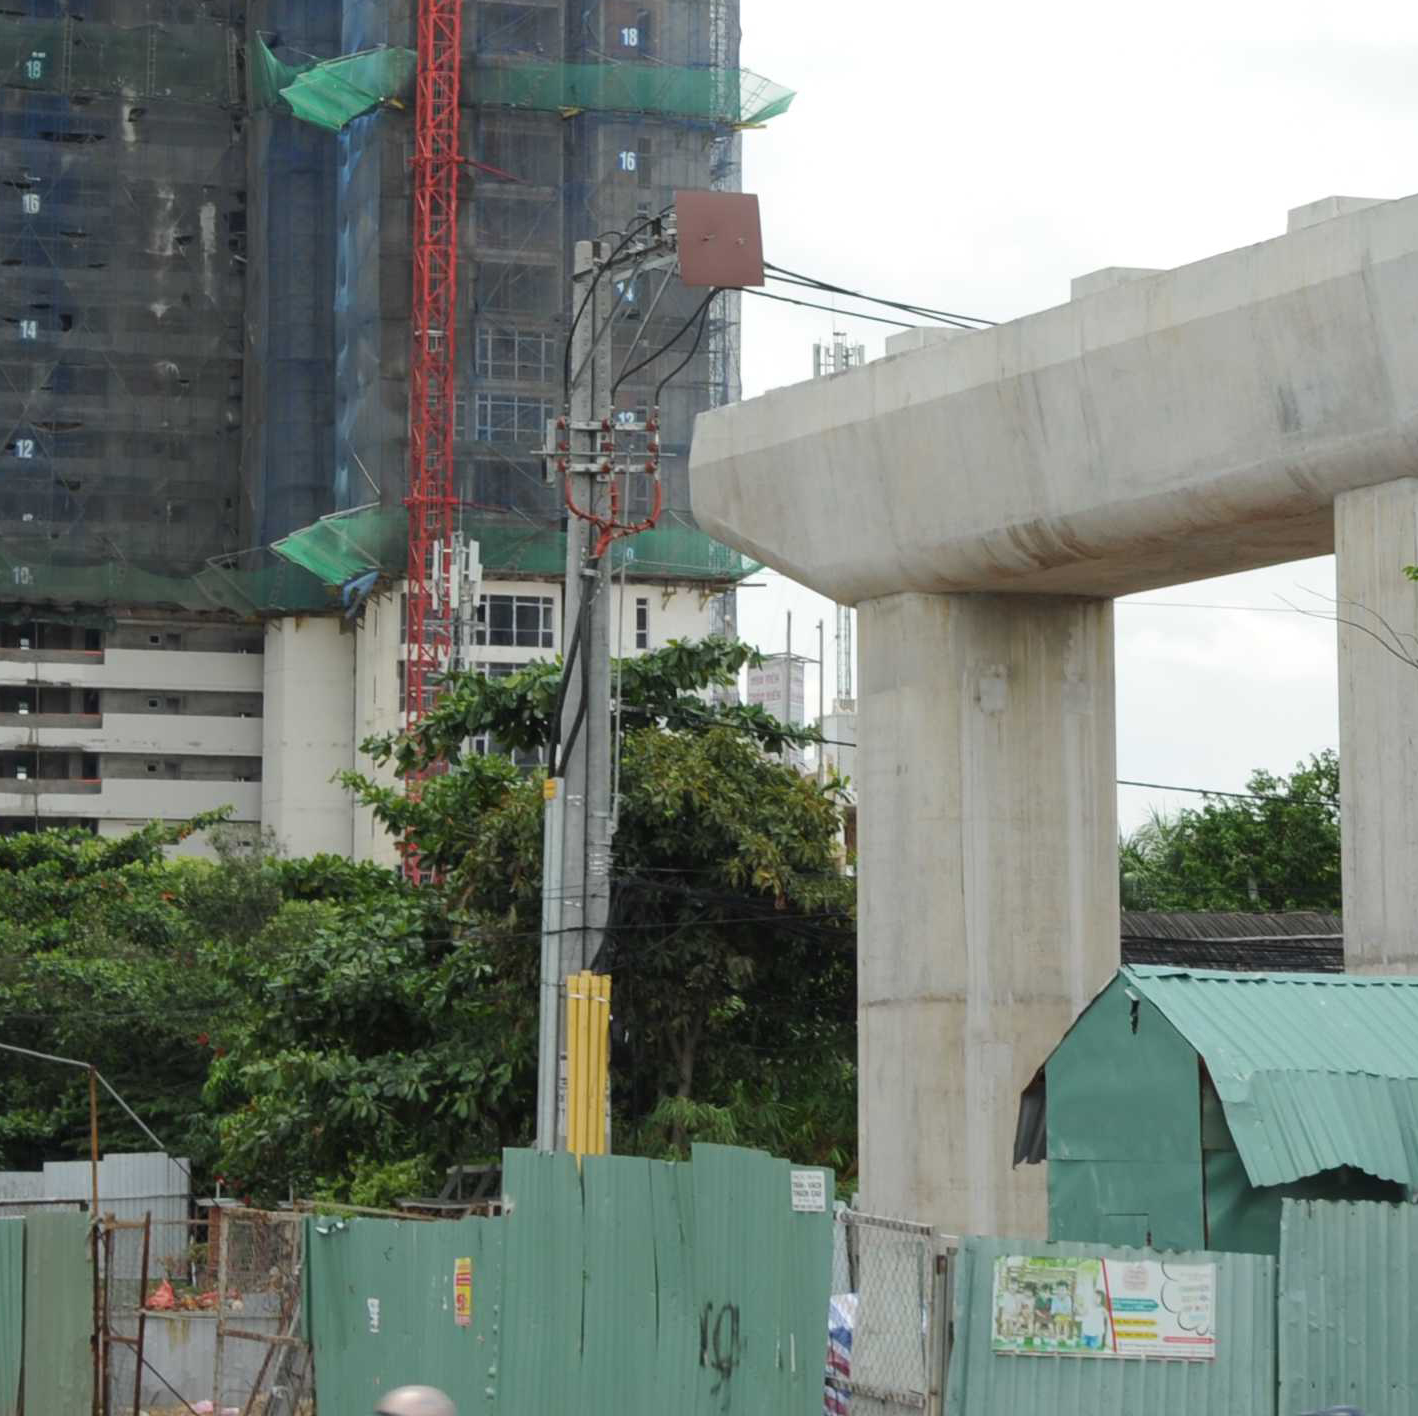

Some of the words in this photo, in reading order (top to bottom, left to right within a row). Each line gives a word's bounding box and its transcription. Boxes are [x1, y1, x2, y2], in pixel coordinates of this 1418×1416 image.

[621, 27, 638, 47] 18
[25, 60, 42, 80] 18
[619, 151, 636, 171] 16
[22, 193, 41, 214] 16
[20, 319, 37, 339] 14
[16, 439, 34, 459] 12
